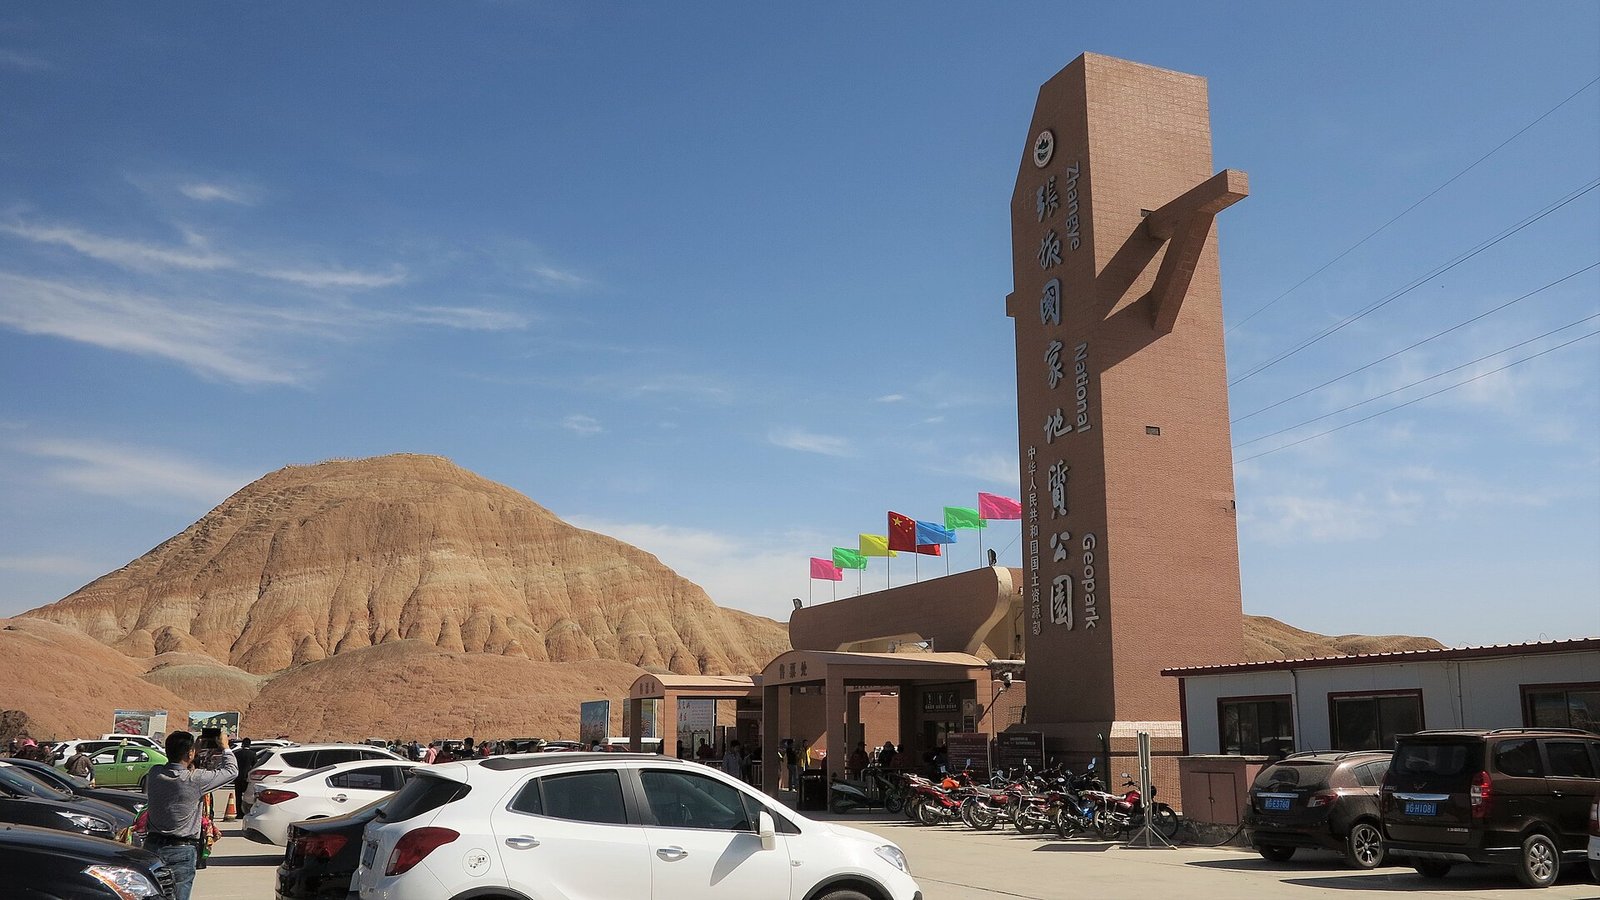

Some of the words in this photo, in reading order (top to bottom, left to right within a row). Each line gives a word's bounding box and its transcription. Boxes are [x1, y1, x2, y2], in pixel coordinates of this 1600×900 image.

[1066, 161, 1080, 250] Zhangye
[1074, 342, 1091, 433] National
[1027, 445, 1041, 636] 中华人民共和国国土资源部
[1082, 532, 1099, 630] Geopark
